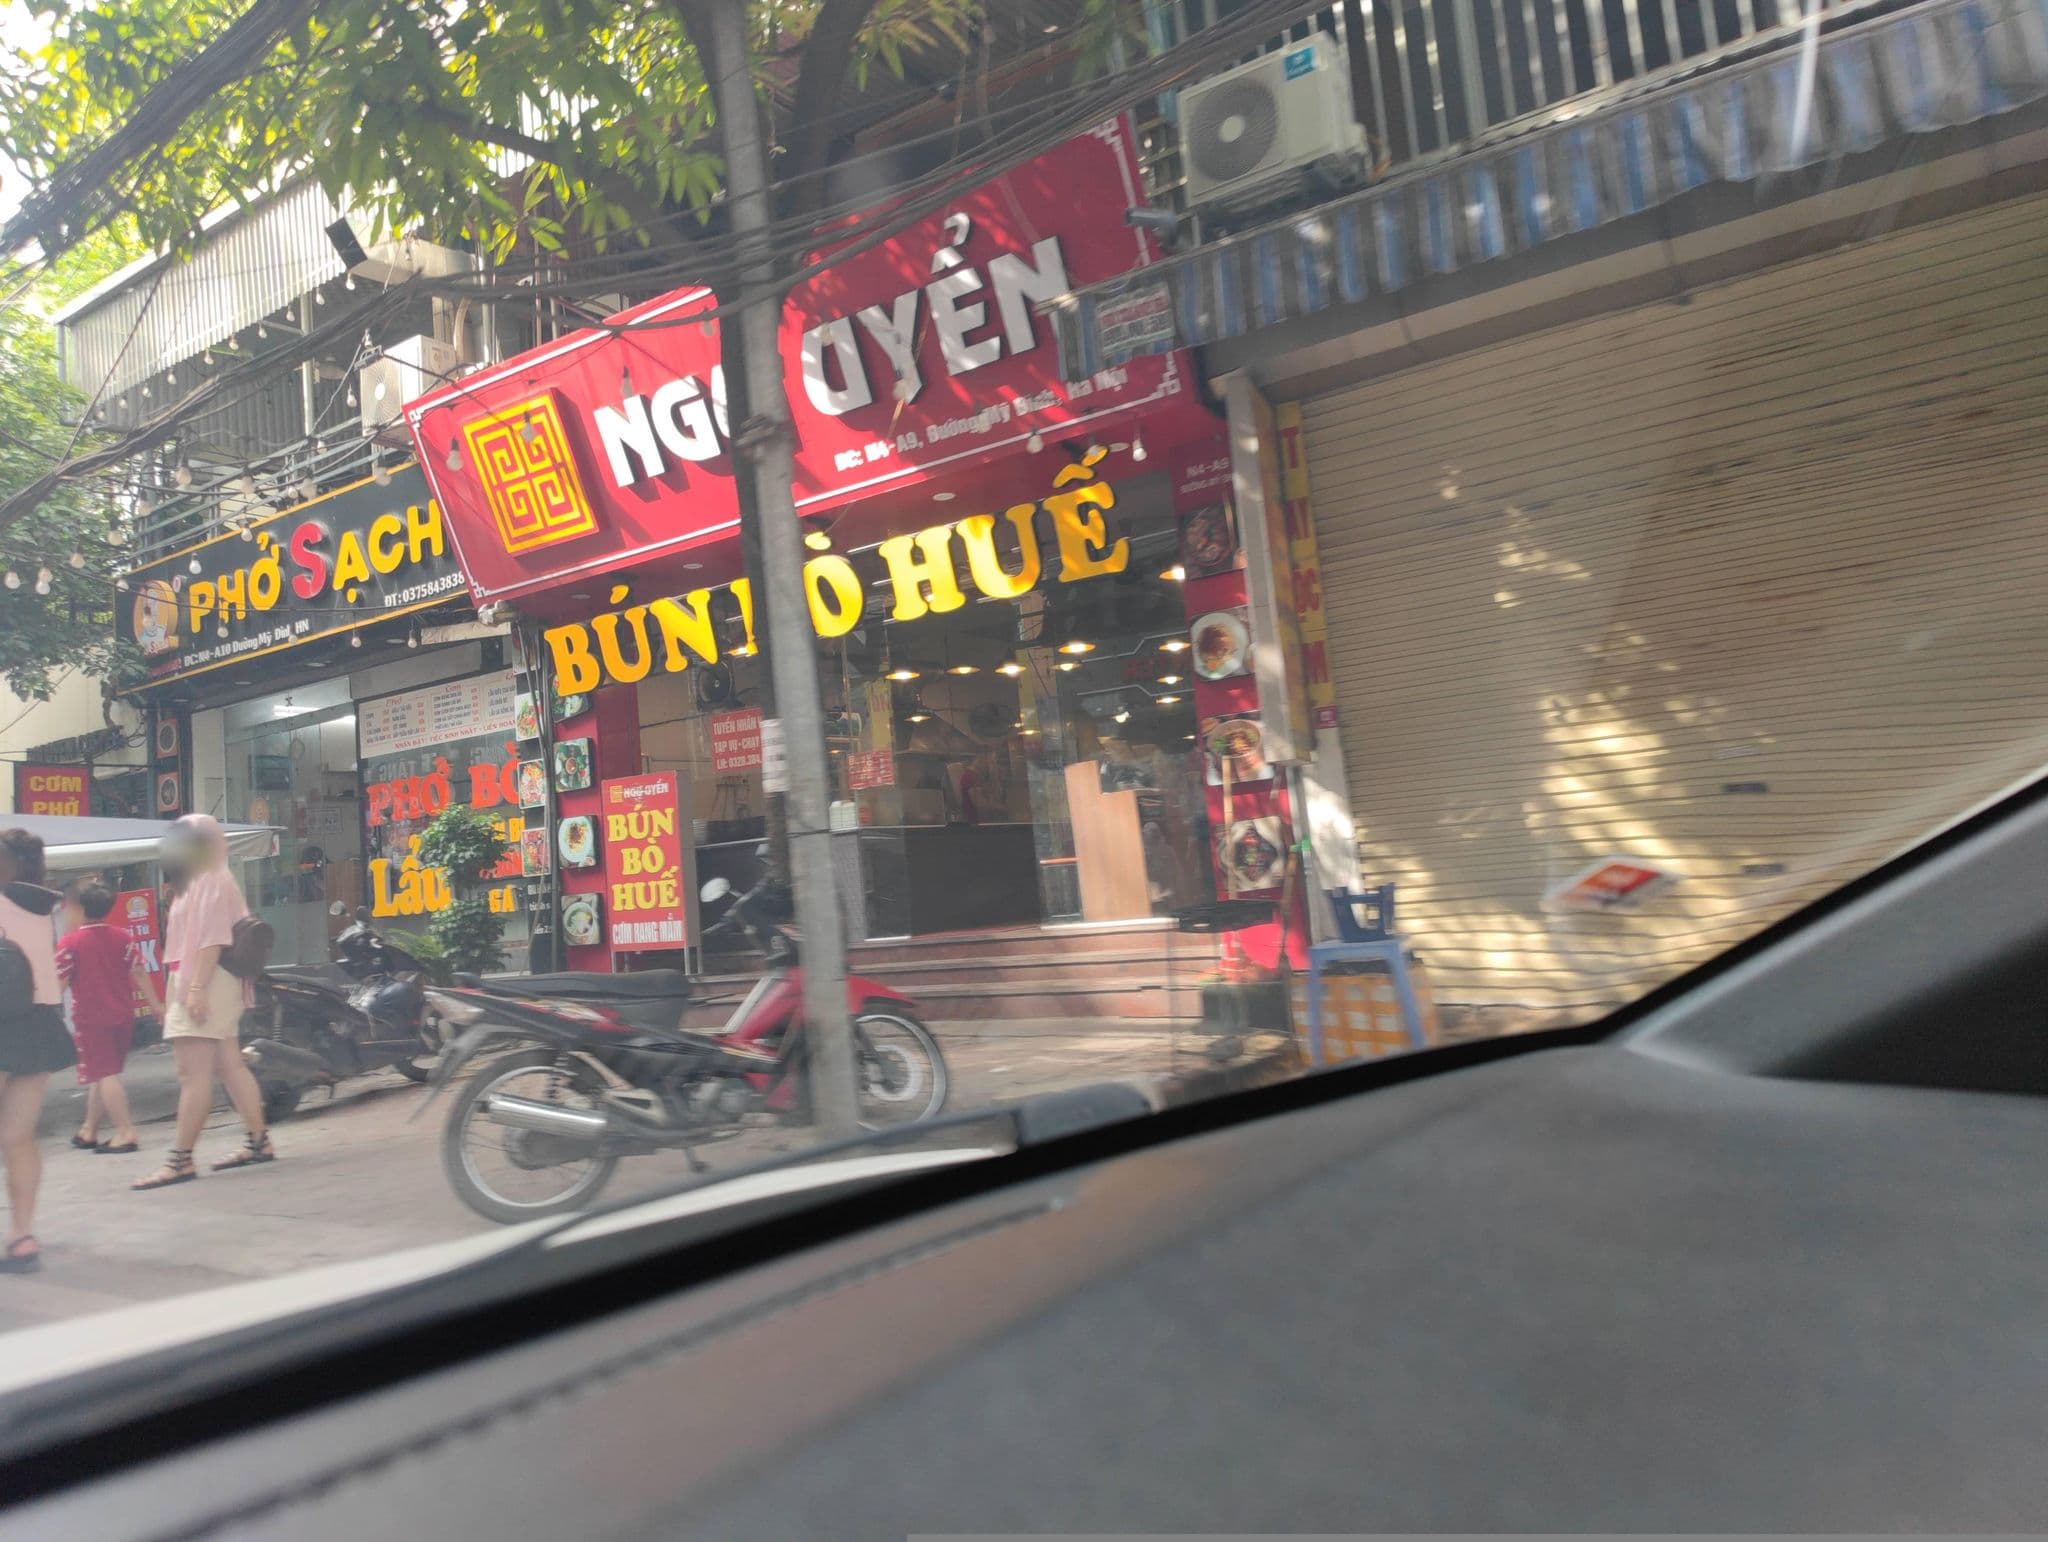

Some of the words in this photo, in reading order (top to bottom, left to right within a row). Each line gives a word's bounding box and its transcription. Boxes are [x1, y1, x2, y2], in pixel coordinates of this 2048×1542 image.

[189, 531, 281, 633] PHỞ
[290, 499, 444, 603] SẠCH
[544, 584, 718, 697] BÚN
[879, 446, 1129, 621] HUẾ
[295, 618, 310, 635] HN
[30, 775, 82, 793] CƠM
[367, 756, 451, 826] PHỞ
[607, 803, 675, 842] BÚN
[369, 834, 452, 917] Lẩu
[621, 837, 665, 875] BÒ
[612, 866, 680, 912] HUẾ
